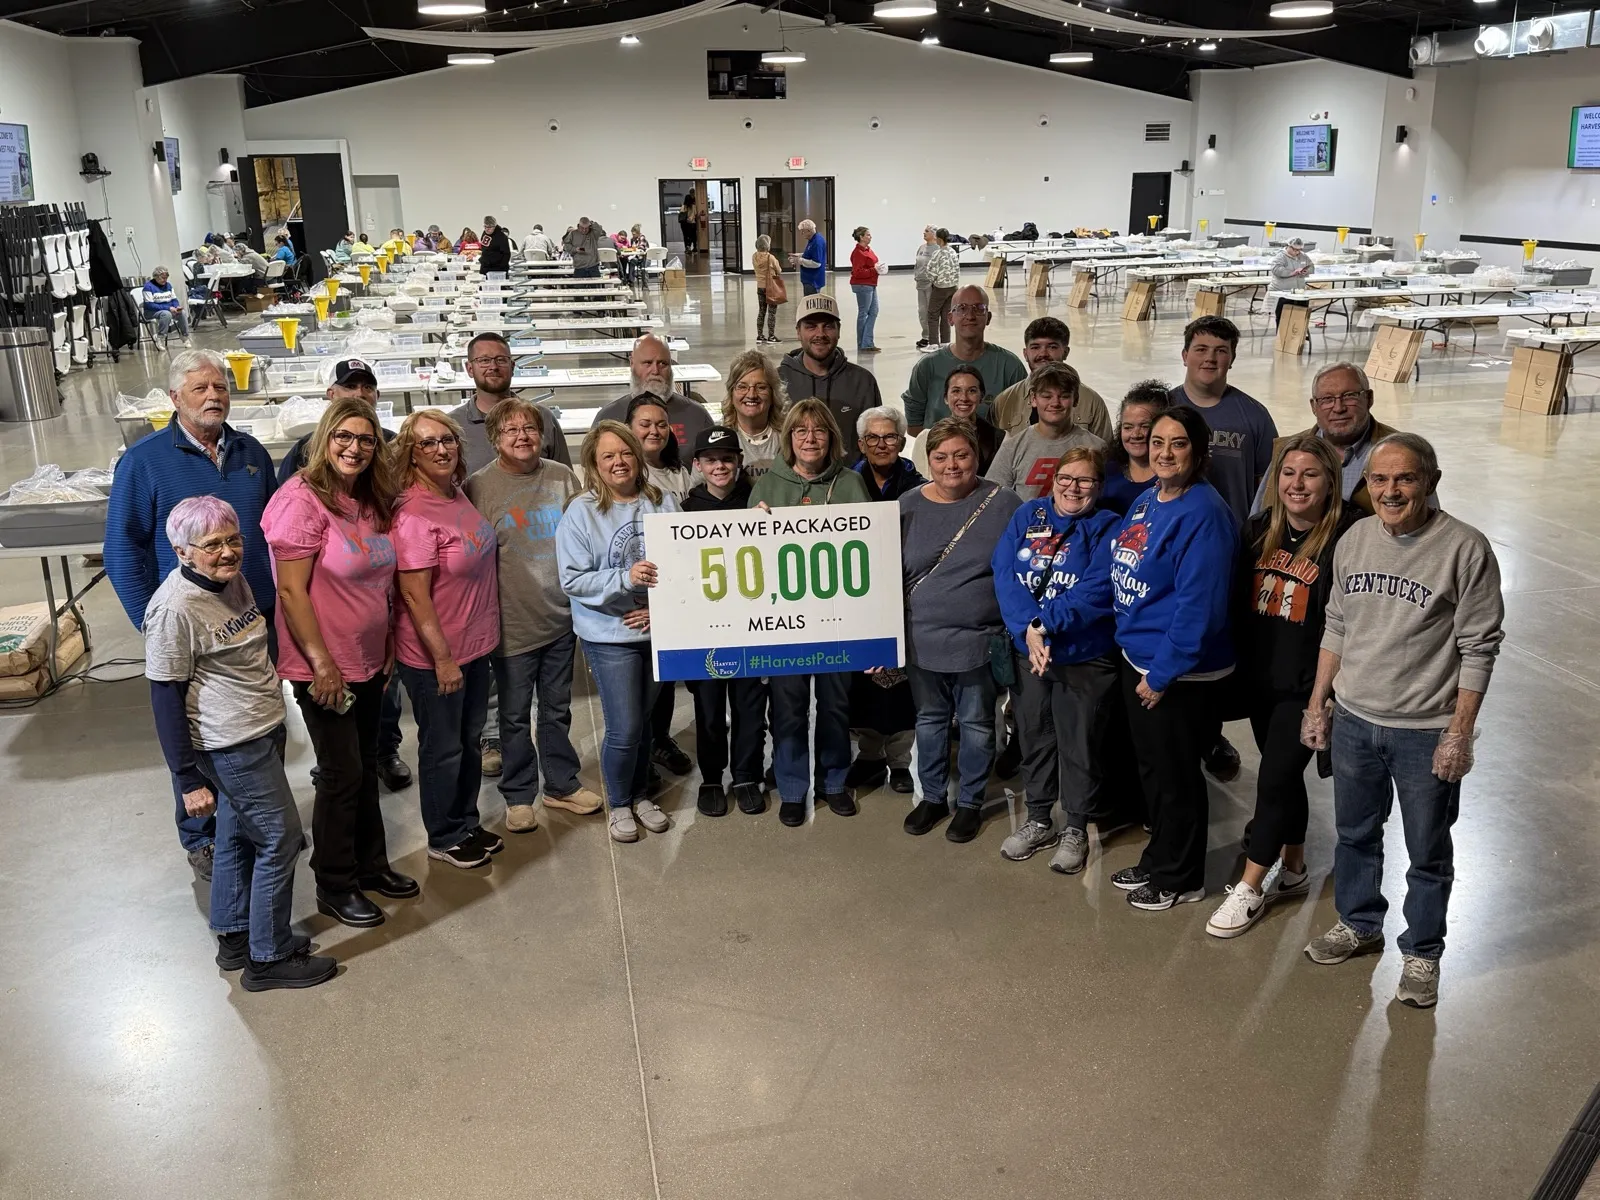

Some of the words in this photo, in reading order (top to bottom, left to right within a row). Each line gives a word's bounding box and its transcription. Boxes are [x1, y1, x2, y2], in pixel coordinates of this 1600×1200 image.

[671, 523, 733, 540] TODAY
[738, 521, 767, 537] WE
[773, 516, 871, 535] PACKAGED
[700, 540, 870, 605] 50,000
[1345, 572, 1433, 609] KENTUCKY
[748, 615, 806, 631] MEALS
[750, 649, 850, 668] #HarvestPack
